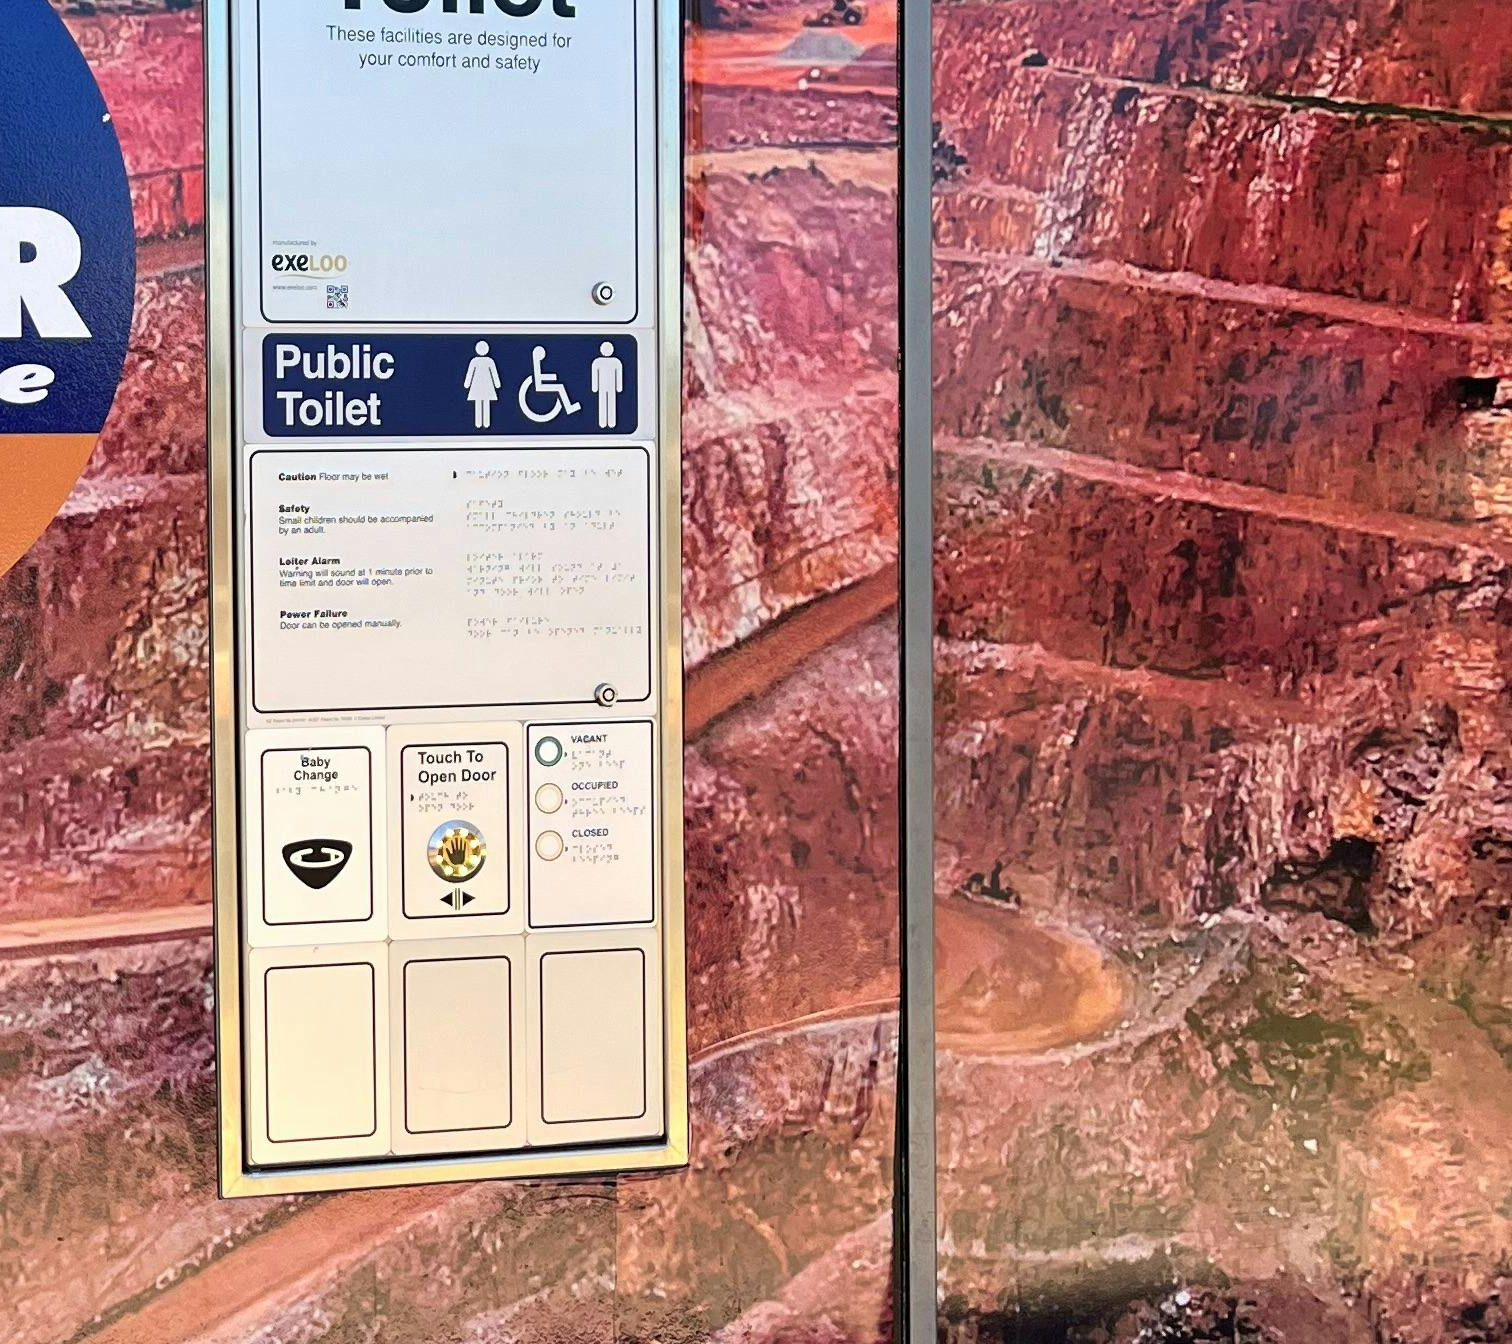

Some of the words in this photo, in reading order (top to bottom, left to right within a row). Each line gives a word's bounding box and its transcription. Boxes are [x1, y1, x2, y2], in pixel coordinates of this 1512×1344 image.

[326, 24, 375, 43] These
[380, 27, 442, 44] facilities
[447, 33, 473, 45] are
[477, 30, 547, 50] designed
[552, 32, 572, 48] for
[358, 52, 393, 69] your
[397, 52, 457, 68] comfort
[461, 54, 490, 69] and
[495, 54, 541, 74] safety
[276, 344, 395, 380] Public
[276, 390, 382, 427] Toilet
[278, 472, 317, 482] Caution
[319, 472, 340, 481] Floor
[342, 474, 359, 483] may
[361, 472, 372, 481] be
[374, 472, 389, 481] wet
[278, 504, 310, 514] Safety
[278, 515, 302, 525] Small
[303, 515, 337, 524] children
[338, 515, 366, 524] should
[367, 515, 378, 524] be
[380, 514, 434, 526] accompanied
[278, 526, 288, 536] by
[279, 557, 309, 566] Loiter
[311, 556, 341, 566] Alarm
[279, 568, 314, 579] Warning
[315, 568, 329, 577] will
[330, 568, 356, 577] sound
[357, 568, 366, 577] at
[375, 567, 403, 576] minute
[404, 567, 423, 577] prior
[425, 567, 433, 575] to
[279, 579, 297, 587] time
[299, 578, 316, 587] limit
[318, 578, 334, 587] and
[335, 578, 354, 586] door
[356, 577, 370, 586] will
[279, 610, 311, 619] Power
[314, 609, 348, 619] Failure
[280, 621, 300, 630] Door
[301, 621, 317, 630] can
[319, 620, 330, 629] be
[331, 619, 363, 630] opened
[570, 734, 608, 744] VACANT
[301, 756, 331, 769] Baby
[417, 750, 462, 765] Touch
[466, 749, 484, 763] To
[293, 769, 339, 783] Change
[418, 769, 457, 786] Open
[461, 768, 497, 782] Door
[571, 781, 619, 791] OCCUPIED
[571, 828, 609, 838] CLOSED
